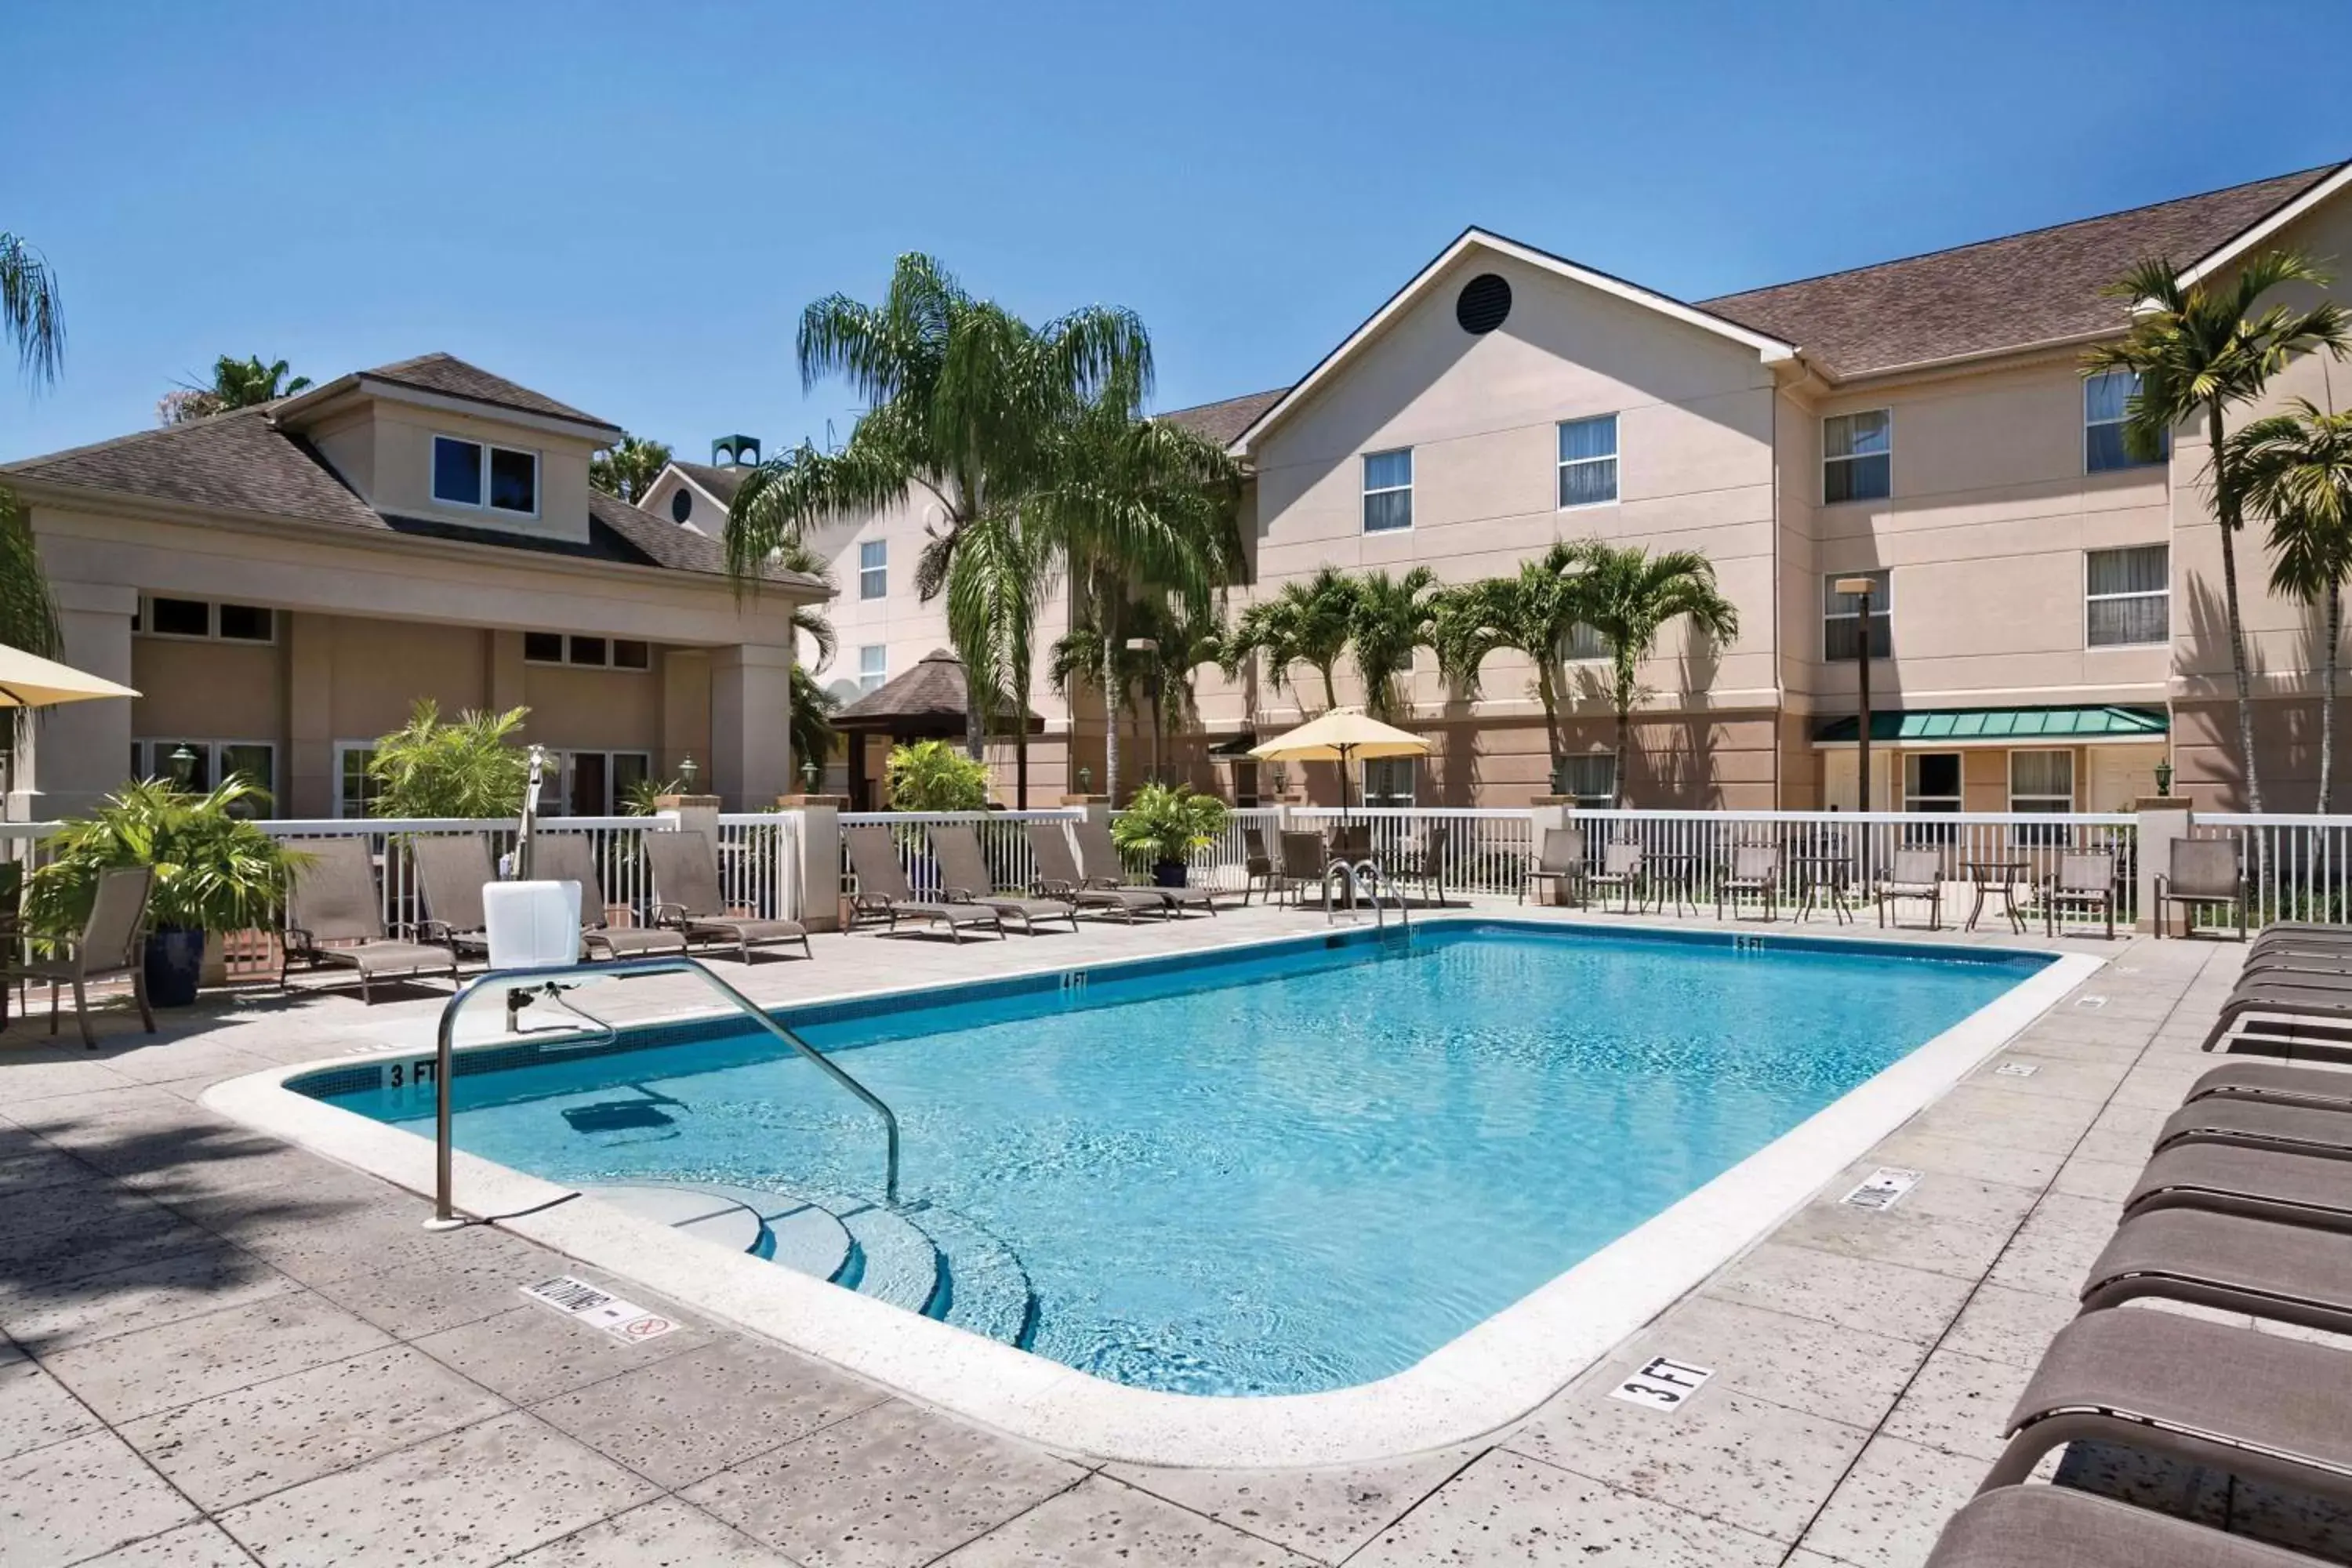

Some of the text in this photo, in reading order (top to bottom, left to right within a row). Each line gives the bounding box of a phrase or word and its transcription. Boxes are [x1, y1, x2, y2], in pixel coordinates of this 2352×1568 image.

[1737, 936, 1762, 950] 5 FT
[1073, 971, 1085, 987] FT
[390, 1059, 437, 1087] 3 FT
[1623, 1357, 1708, 1402] 3 FT
